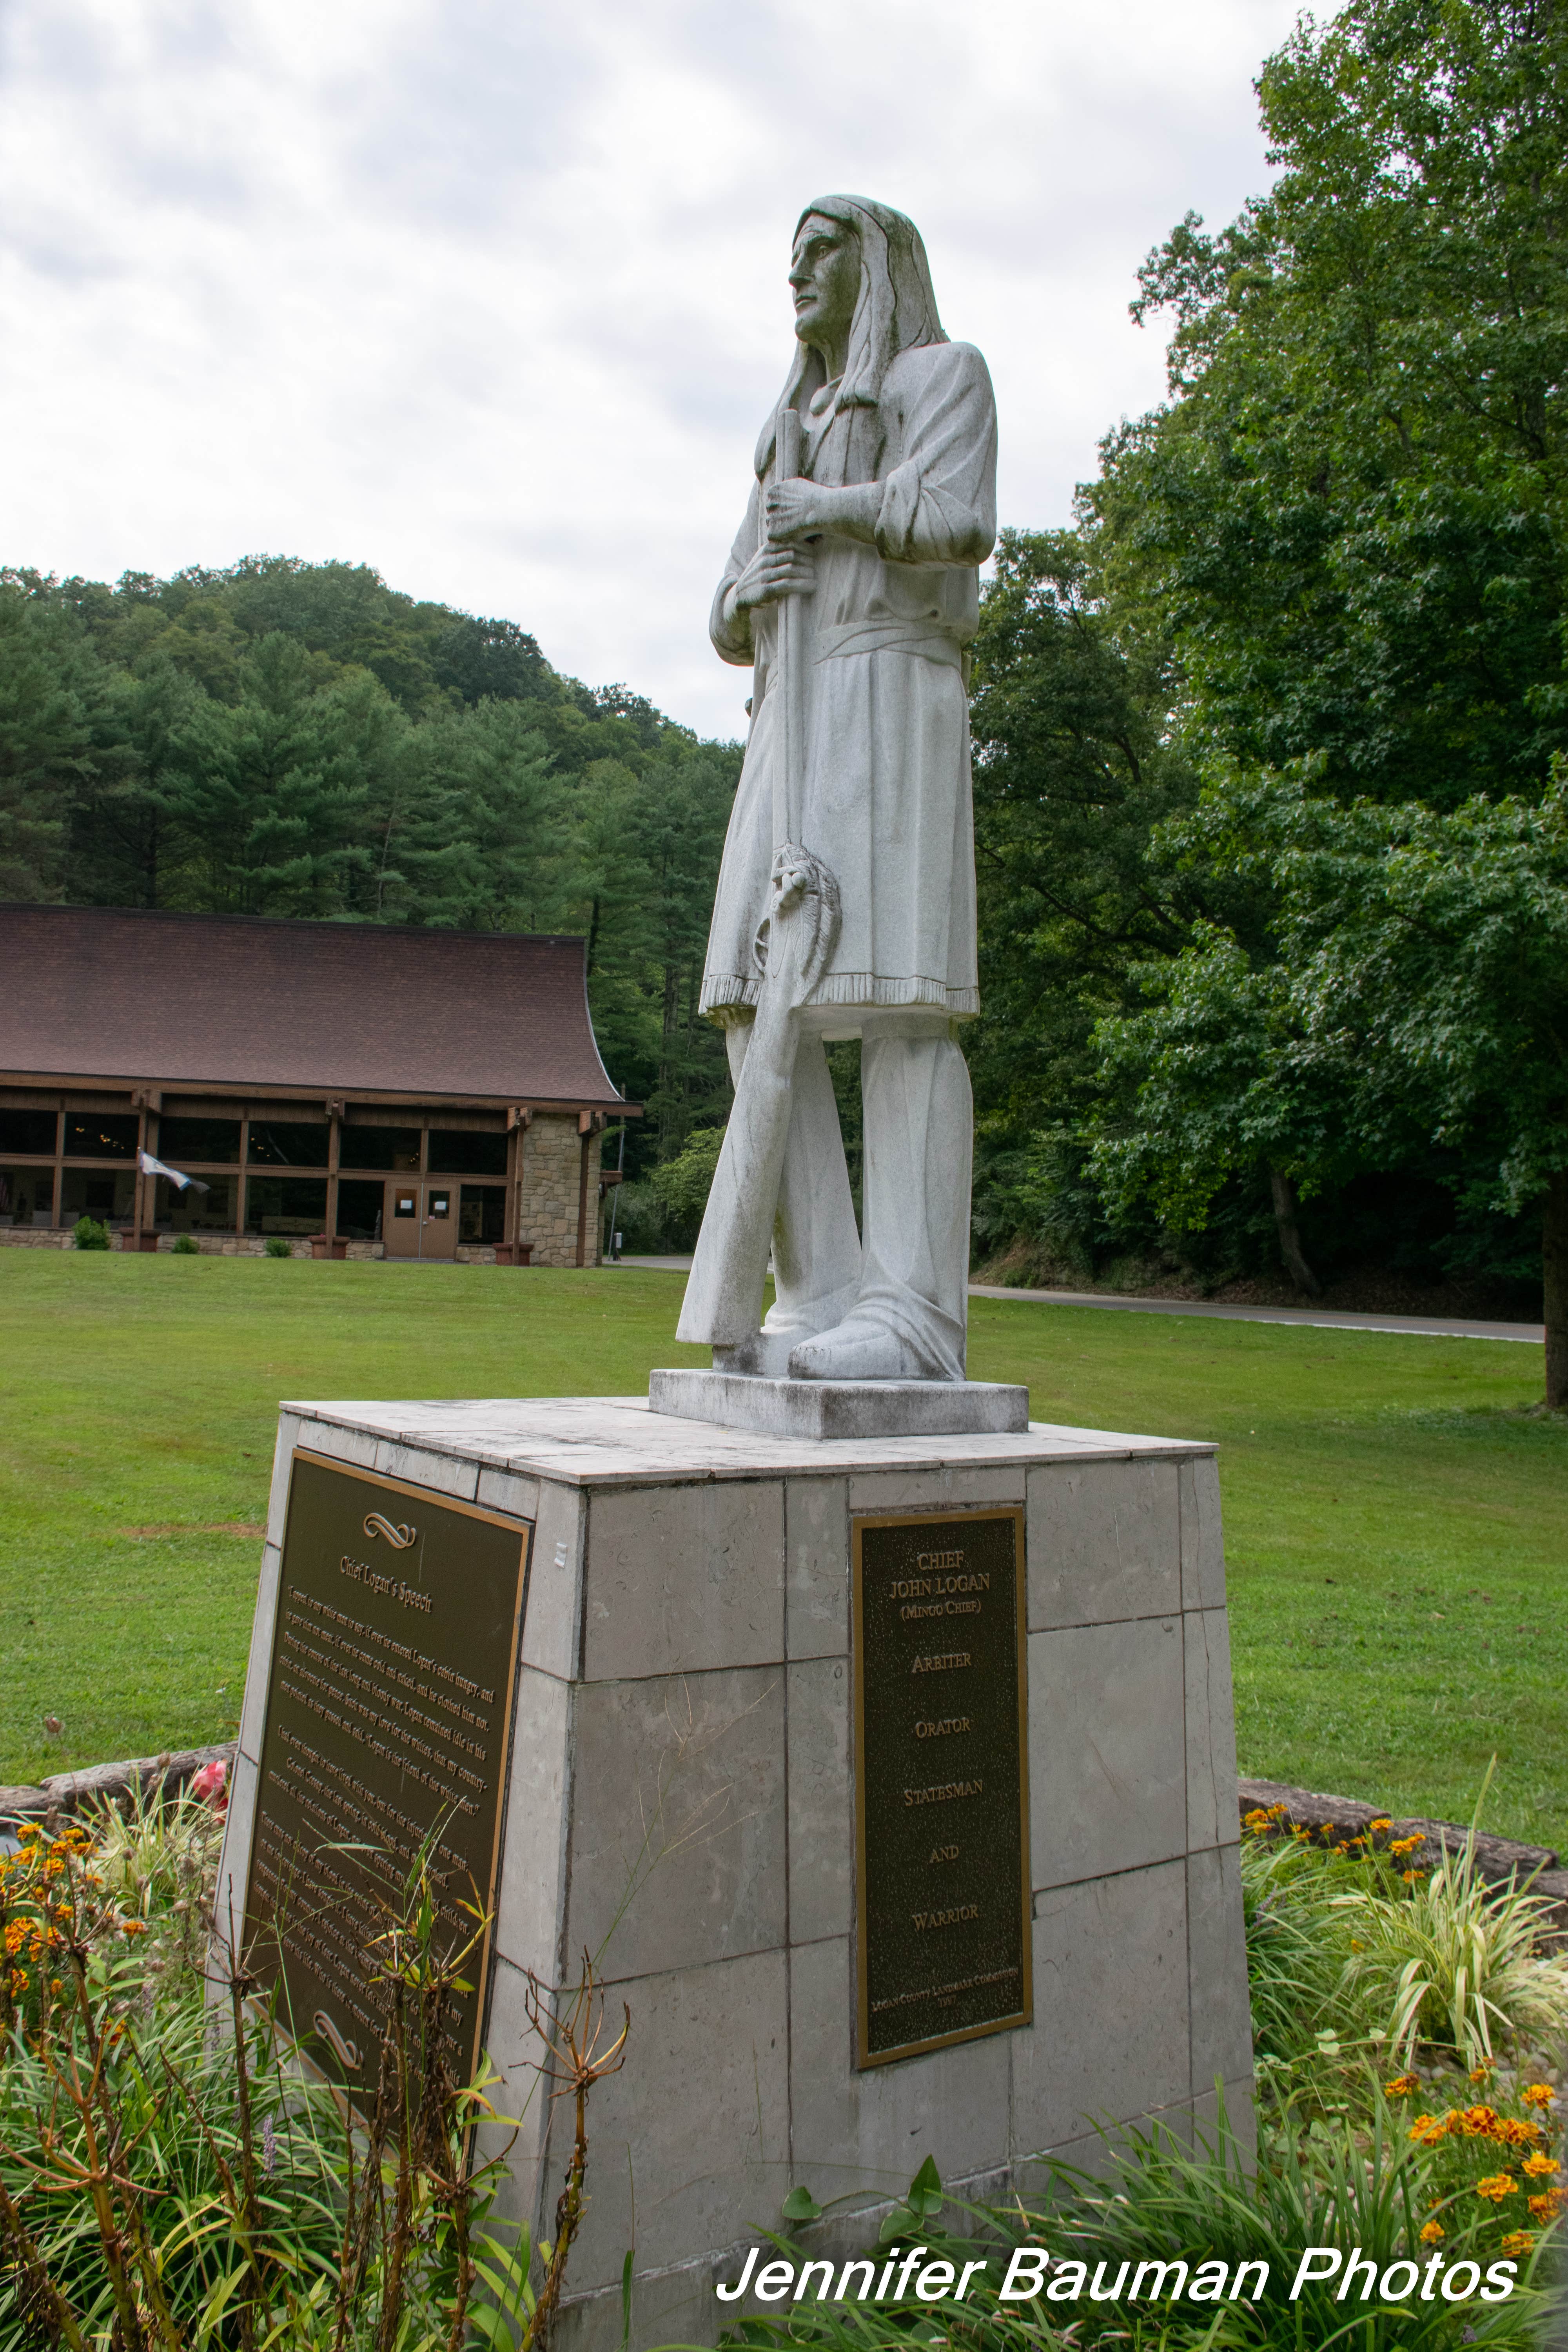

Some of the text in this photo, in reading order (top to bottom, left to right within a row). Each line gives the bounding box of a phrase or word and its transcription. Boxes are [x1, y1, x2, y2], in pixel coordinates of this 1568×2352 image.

[917, 1550, 964, 1570] CHIEF
[340, 1555, 433, 1613] Chief Logan's Speech
[890, 1573, 990, 1599] JOHN LOGAN
[337, 1613, 348, 1626] man
[348, 1616, 354, 1629] to
[365, 1625, 372, 1638] if
[371, 1631, 383, 1644] ever
[383, 1635, 392, 1649] he
[391, 1642, 413, 1660] entered
[413, 1650, 437, 1673] Logan's
[437, 1666, 455, 1683] cabin
[456, 1673, 479, 1698] hungry,
[481, 1689, 495, 1704] and
[284, 1631, 300, 1652] During
[339, 1663, 349, 1678] last
[349, 1669, 361, 1689] long
[361, 1680, 372, 1692] and
[372, 1683, 390, 1706] bloody
[391, 1697, 404, 1713] war,
[404, 1702, 423, 1723] Logan
[423, 1717, 452, 1740] remained
[452, 1730, 466, 1749] idle
[466, 1739, 474, 1754] in
[475, 1743, 486, 1761] his
[340, 1641, 352, 1654] ever
[352, 1644, 359, 1659] he
[359, 1651, 373, 1666] came
[373, 1659, 387, 1673] cold
[386, 1667, 397, 1680] and
[397, 1673, 416, 1692] naked,
[417, 1684, 429, 1697] and
[429, 1688, 437, 1703] he
[437, 1694, 462, 1716] clothed
[462, 1706, 475, 1724] him
[475, 1717, 490, 1733] not.
[345, 1693, 358, 1711] Such
[358, 1704, 369, 1718] was
[369, 1711, 379, 1727] my
[378, 1714, 392, 1732] love
[391, 1722, 401, 1738] for
[401, 1728, 410, 1744] the
[411, 1737, 433, 1760] whites,
[434, 1748, 447, 1767] that
[447, 1760, 458, 1777] my
[458, 1767, 487, 1793] country-
[915, 1717, 971, 1738] ORATOR
[342, 1721, 352, 1734] and
[366, 1732, 386, 1757] "Logan
[385, 1746, 392, 1760] is
[392, 1750, 402, 1767] the
[402, 1757, 421, 1779] friend
[421, 1773, 430, 1785] of
[429, 1775, 440, 1792] the
[440, 1786, 459, 1805] white
[333, 1791, 344, 1808] last
[343, 1802, 361, 1824] spring,
[361, 1813, 368, 1827] in
[368, 1821, 381, 1836] cold
[399, 1845, 411, 1859] and
[338, 1768, 352, 1787] lived
[352, 1781, 365, 1797] with
[364, 1790, 376, 1807] you,
[376, 1796, 387, 1813] but
[387, 1803, 397, 1820] for
[396, 1810, 406, 1827] the
[407, 1818, 430, 1844] injurie
[439, 1844, 452, 1861] one
[324, 1864, 339, 1885] blood
[374, 1853, 395, 1879] sparing
[395, 1870, 404, 1887] my
[929, 1845, 959, 1864] AND
[912, 1904, 978, 1933] WARRIOR
[345, 1910, 358, 1931] have
[451, 2007, 463, 2028] my
[410, 1997, 419, 2015] do
[449, 2066, 461, 2086] his
